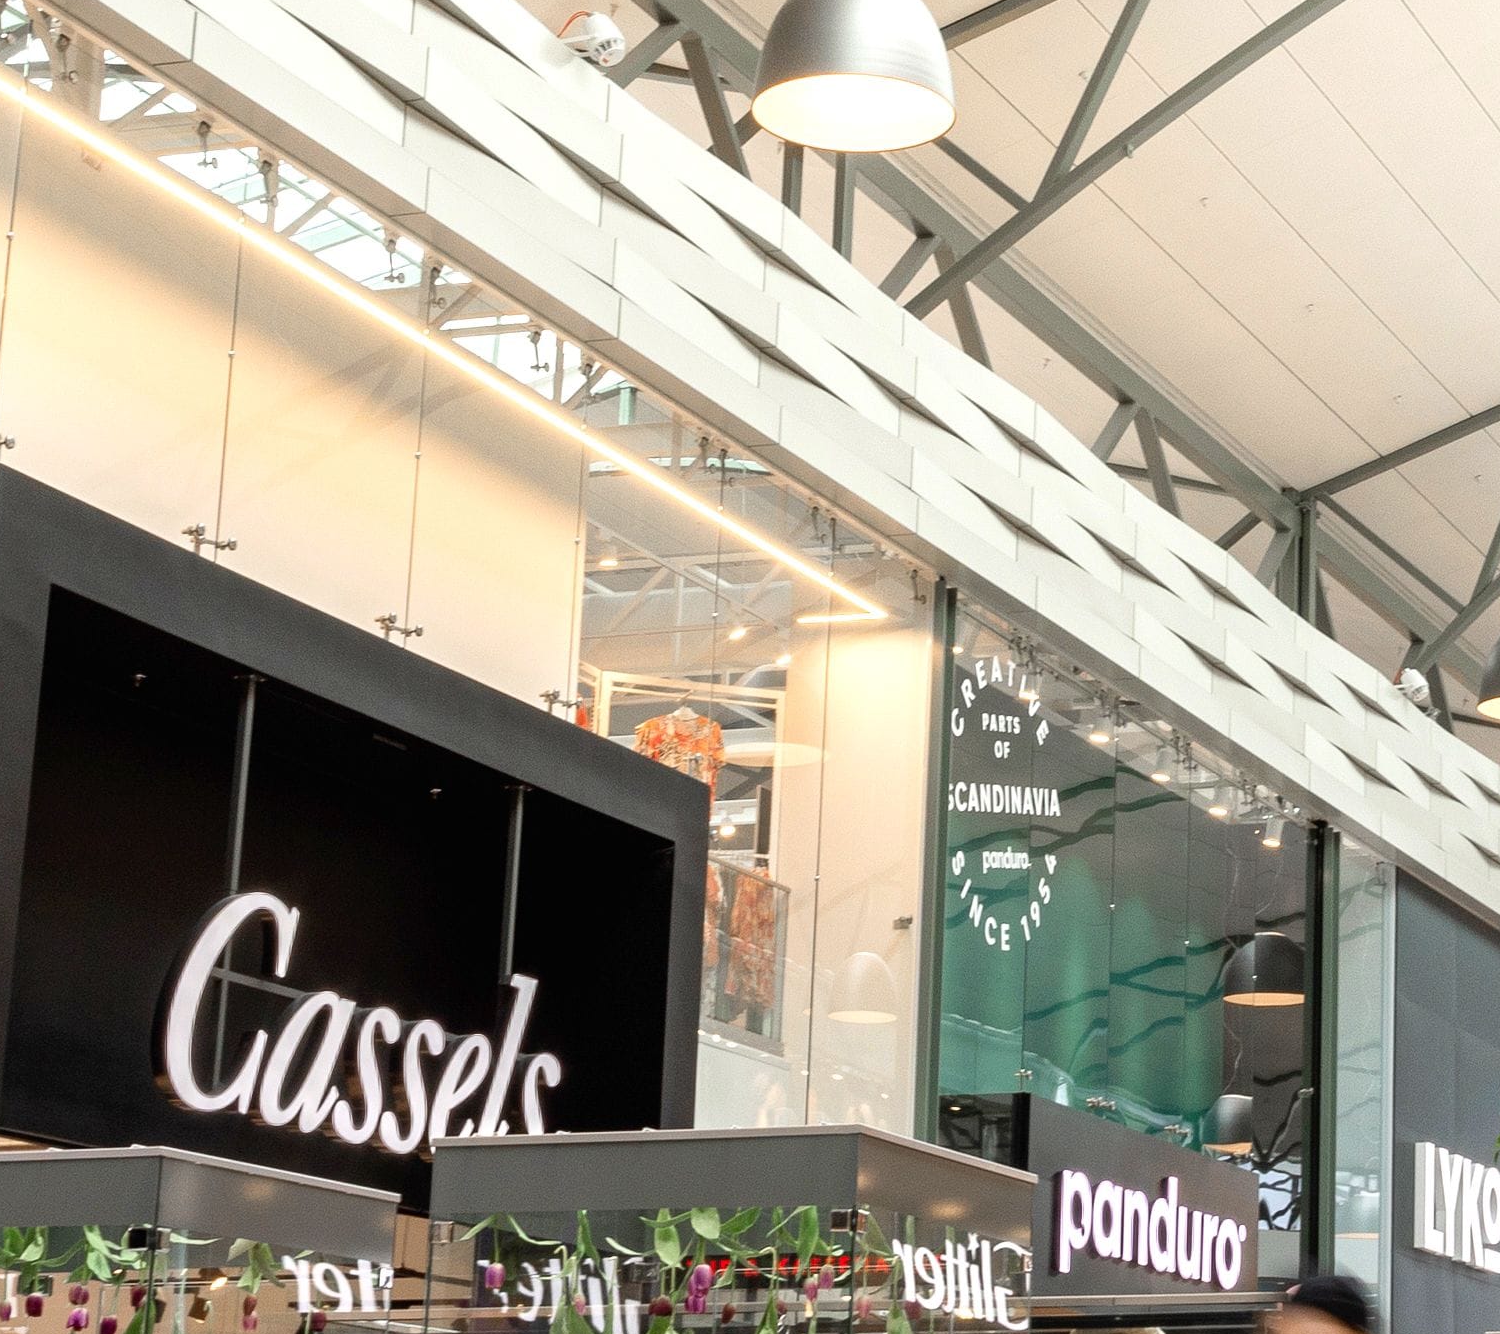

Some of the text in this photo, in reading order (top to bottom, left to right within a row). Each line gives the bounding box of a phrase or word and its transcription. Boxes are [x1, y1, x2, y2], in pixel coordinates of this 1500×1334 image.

[981, 712, 1021, 734] PARTS
[993, 740, 1011, 759] OF
[982, 846, 1031, 874] panduro
[952, 850, 1057, 951] SINCE 1954
[164, 891, 561, 1154] Cassels
[1059, 1169, 1247, 1290] panduro
